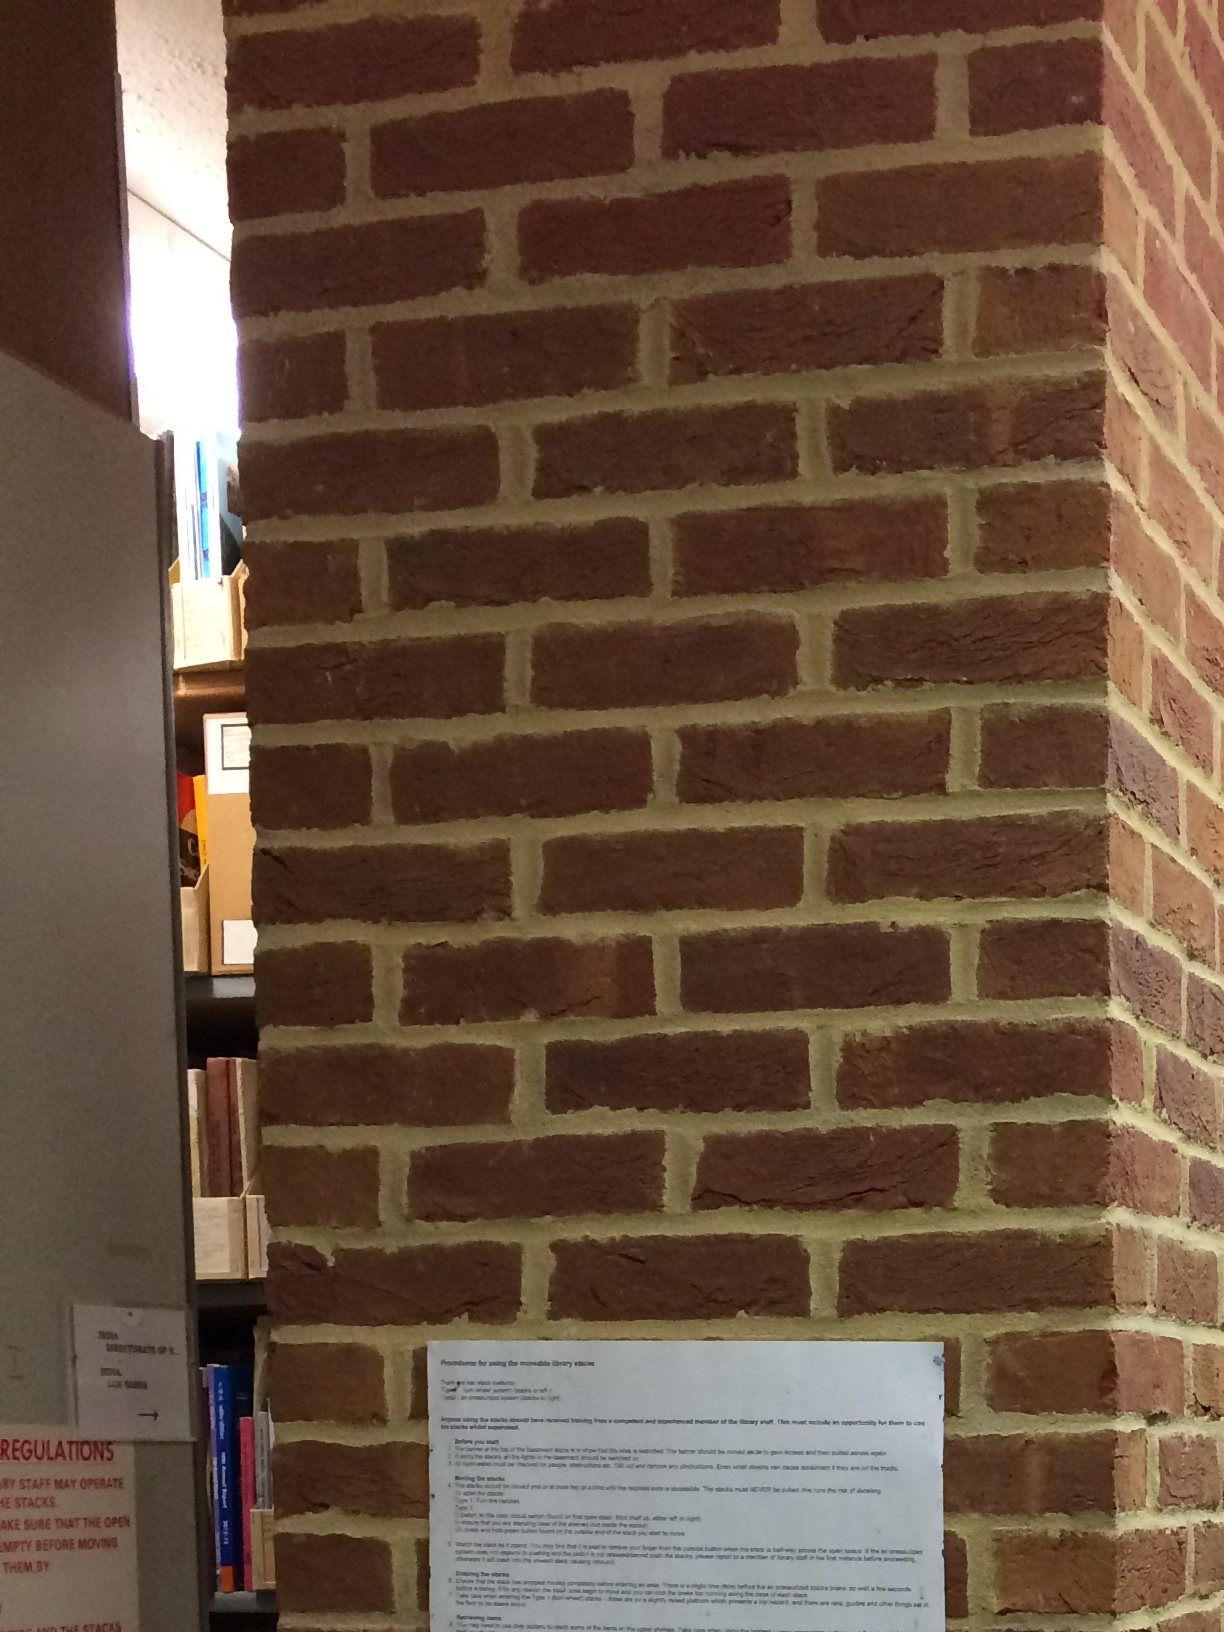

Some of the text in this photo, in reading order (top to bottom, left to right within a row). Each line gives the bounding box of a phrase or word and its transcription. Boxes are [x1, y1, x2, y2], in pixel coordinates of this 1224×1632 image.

[0, 1439, 114, 1462] REGULATIONS
[19, 1478, 51, 1490] STAFF
[54, 1478, 77, 1490] MAY
[80, 1477, 125, 1489] OPERATE
[24, 1518, 51, 1531] SURE
[54, 1517, 81, 1530] THAT
[83, 1516, 101, 1529] THE
[104, 1515, 131, 1528] OPEN
[35, 1539, 75, 1551] BEFORE
[78, 1537, 119, 1550] MOVING
[2, 1561, 33, 1573] THEM
